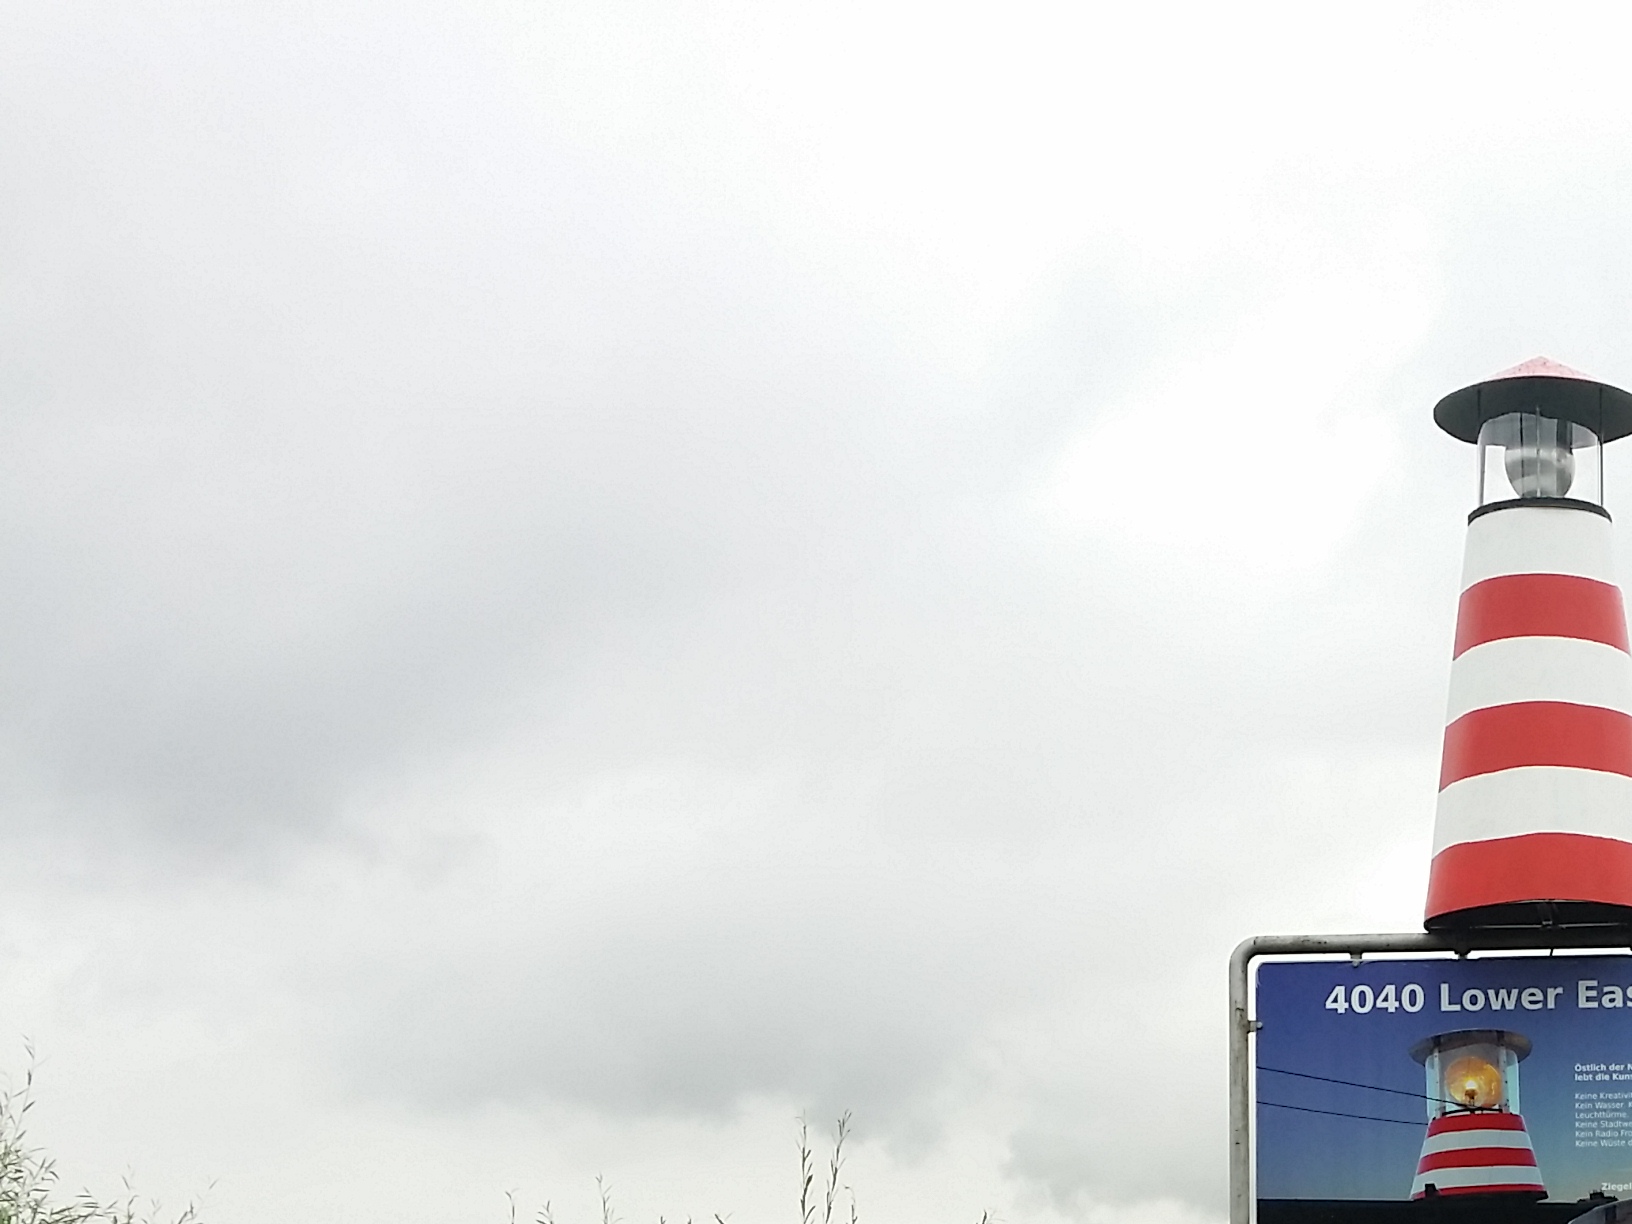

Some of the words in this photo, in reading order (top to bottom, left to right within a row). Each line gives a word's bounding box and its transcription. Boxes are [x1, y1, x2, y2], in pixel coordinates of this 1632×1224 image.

[1324, 983, 1425, 1015] 4040
[1440, 983, 1565, 1012] Lower
[1574, 1063, 1607, 1072] Östlich
[1608, 1063, 1625, 1071] der
[1574, 1073, 1593, 1081] lebt
[1595, 1073, 1610, 1081] die
[1574, 1092, 1598, 1100] Keine
[1575, 1120, 1598, 1128] Keine
[1575, 1130, 1593, 1138] Kein
[1595, 1129, 1619, 1137] Radio
[1575, 1139, 1598, 1147] Keine
[1600, 1139, 1626, 1147] Wüste
